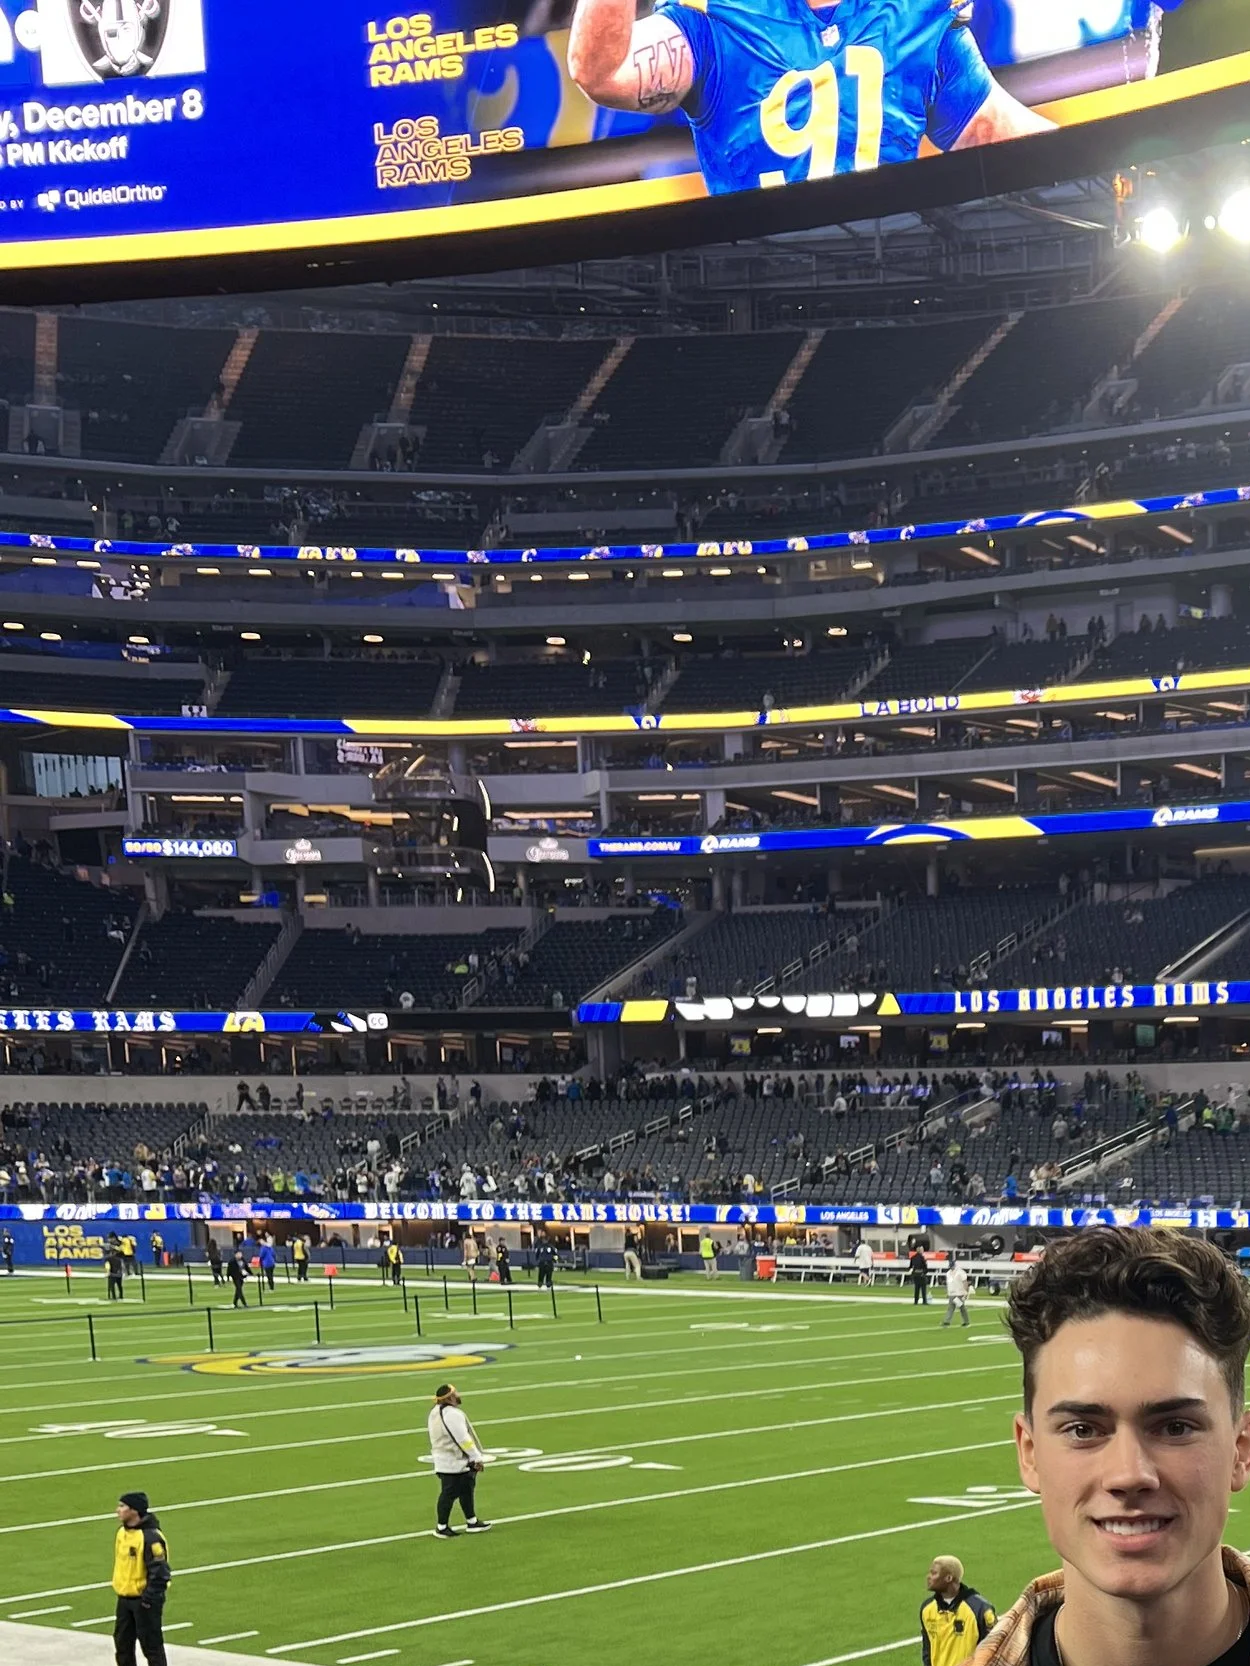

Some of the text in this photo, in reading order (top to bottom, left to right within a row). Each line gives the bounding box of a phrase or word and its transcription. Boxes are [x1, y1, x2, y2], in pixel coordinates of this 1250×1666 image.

[368, 14, 432, 42] LOS
[369, 24, 519, 65] ANGELES
[370, 55, 463, 87] RAMS
[23, 95, 176, 133] December
[182, 88, 204, 120] 8
[760, 45, 884, 180] 91
[373, 116, 439, 145] LOS
[375, 126, 525, 167] ANGELES
[6, 141, 45, 167] PM
[48, 135, 128, 164] Kickoff
[377, 156, 471, 189] RAMS
[899, 696, 959, 714] BOLD
[955, 990, 999, 1013] LOS
[1153, 981, 1230, 1006] RAMS
[92, 1010, 177, 1032] RAMS
[364, 1202, 458, 1220] WELCOME
[467, 1202, 495, 1220] TO
[503, 1202, 543, 1220] THE
[552, 1202, 607, 1221] RAMS
[43, 1225, 83, 1237] LOS
[45, 1247, 103, 1259] RAMS
